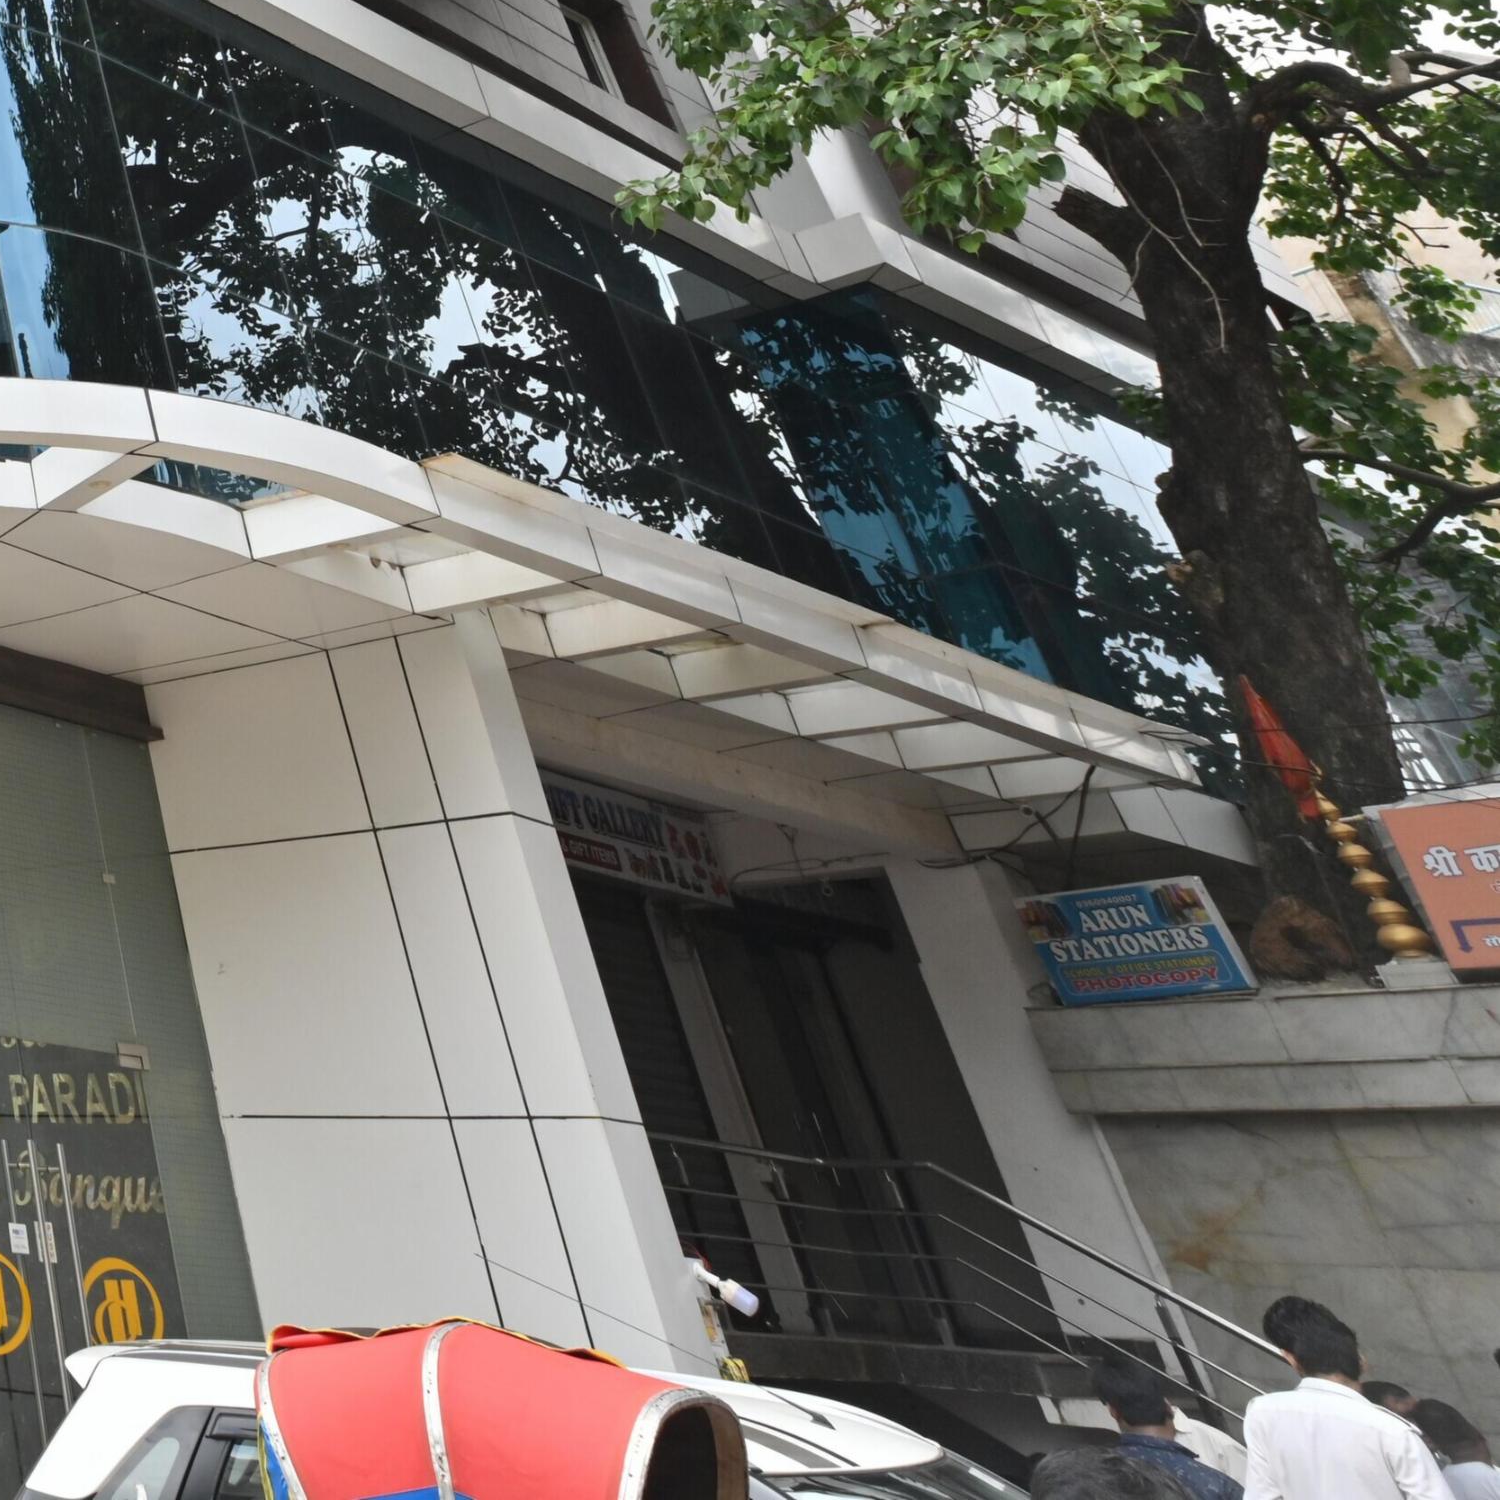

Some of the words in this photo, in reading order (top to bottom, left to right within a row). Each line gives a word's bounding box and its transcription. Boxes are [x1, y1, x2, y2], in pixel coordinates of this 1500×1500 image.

[1423, 845, 1464, 877] श्री
[1079, 904, 1152, 933] ARUN
[1050, 925, 1210, 963] STATIONERS
[1073, 967, 1218, 991] PHOTOCOPY
